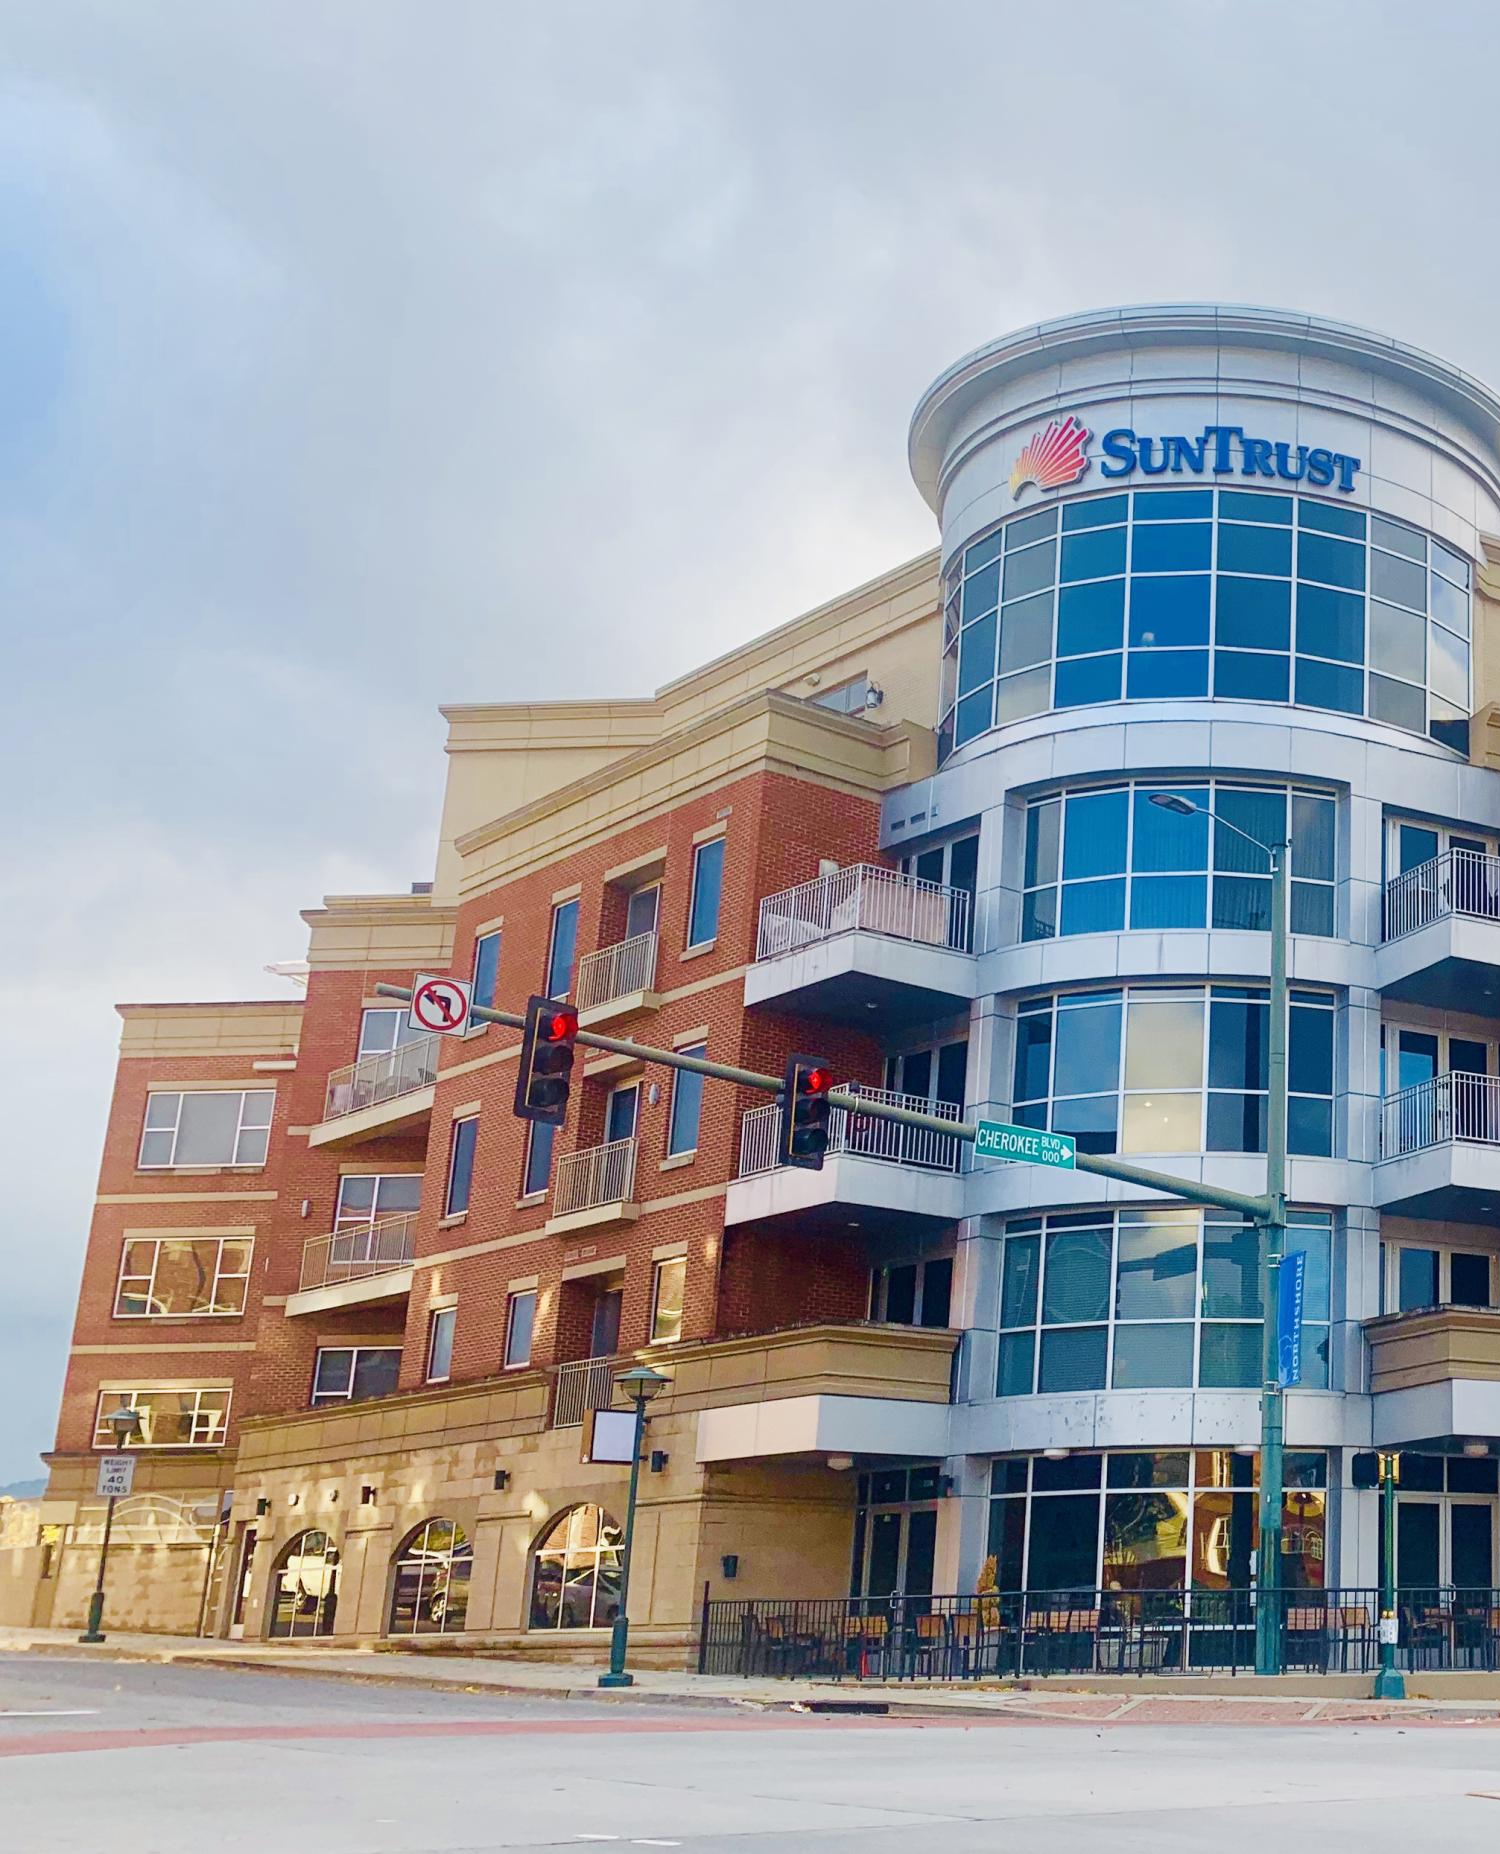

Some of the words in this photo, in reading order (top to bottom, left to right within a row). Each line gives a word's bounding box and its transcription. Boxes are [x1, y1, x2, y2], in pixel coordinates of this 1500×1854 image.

[977, 1129, 1039, 1156] CHEROKEE
[1041, 1136, 1060, 1150] BLVD
[1042, 1150, 1060, 1163] 000
[107, 1476, 124, 1484] 40
[102, 1485, 128, 1493] TONS
